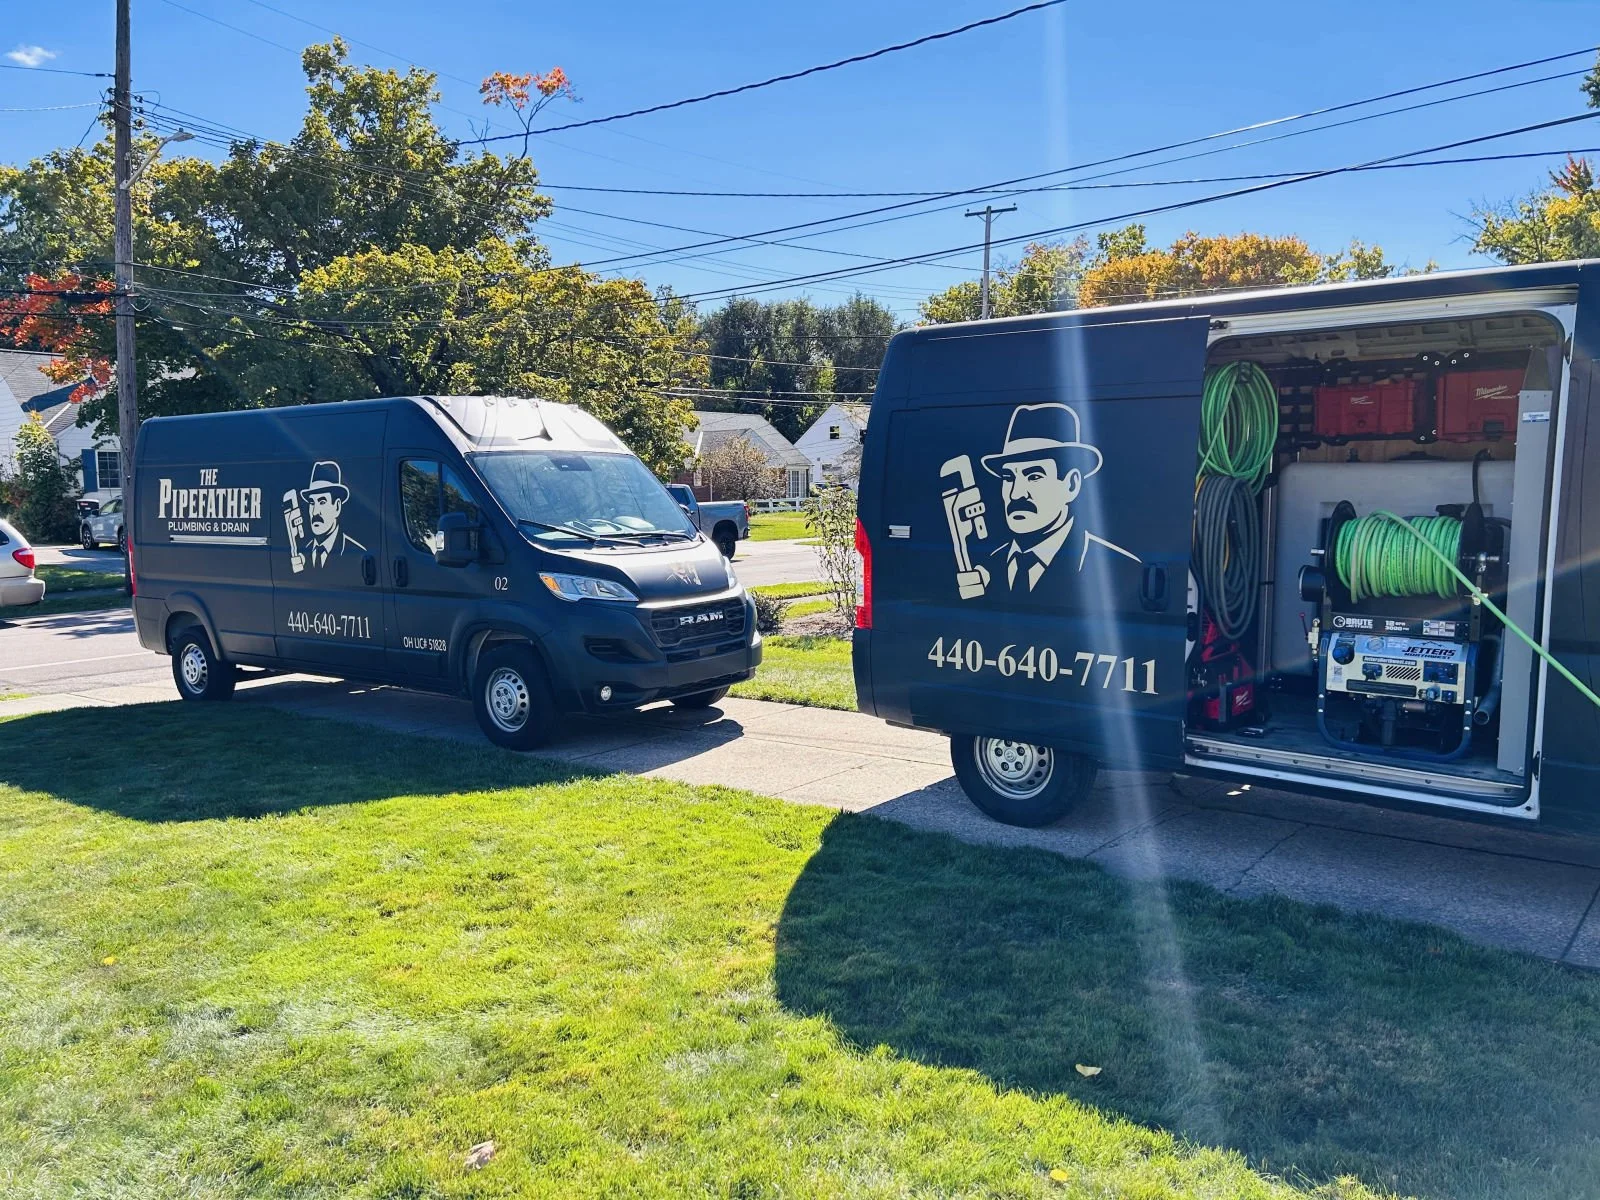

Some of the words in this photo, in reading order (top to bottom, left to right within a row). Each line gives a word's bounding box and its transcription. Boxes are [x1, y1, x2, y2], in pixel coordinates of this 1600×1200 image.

[200, 468, 218, 486] THE
[158, 478, 262, 519] PIPEFATHER
[168, 521, 212, 532] PLUMBING
[213, 522, 220, 532] &
[221, 522, 250, 533] DRAIN
[494, 576, 508, 591] 02
[287, 611, 371, 639] 440-640-7711
[679, 611, 724, 625] RAM
[1345, 617, 1374, 627] BRUTE
[403, 636, 414, 648] OH
[1402, 646, 1457, 657] JETTERS
[1404, 652, 1451, 660] NORTHWEST
[927, 637, 1159, 695] 440-640-7711
